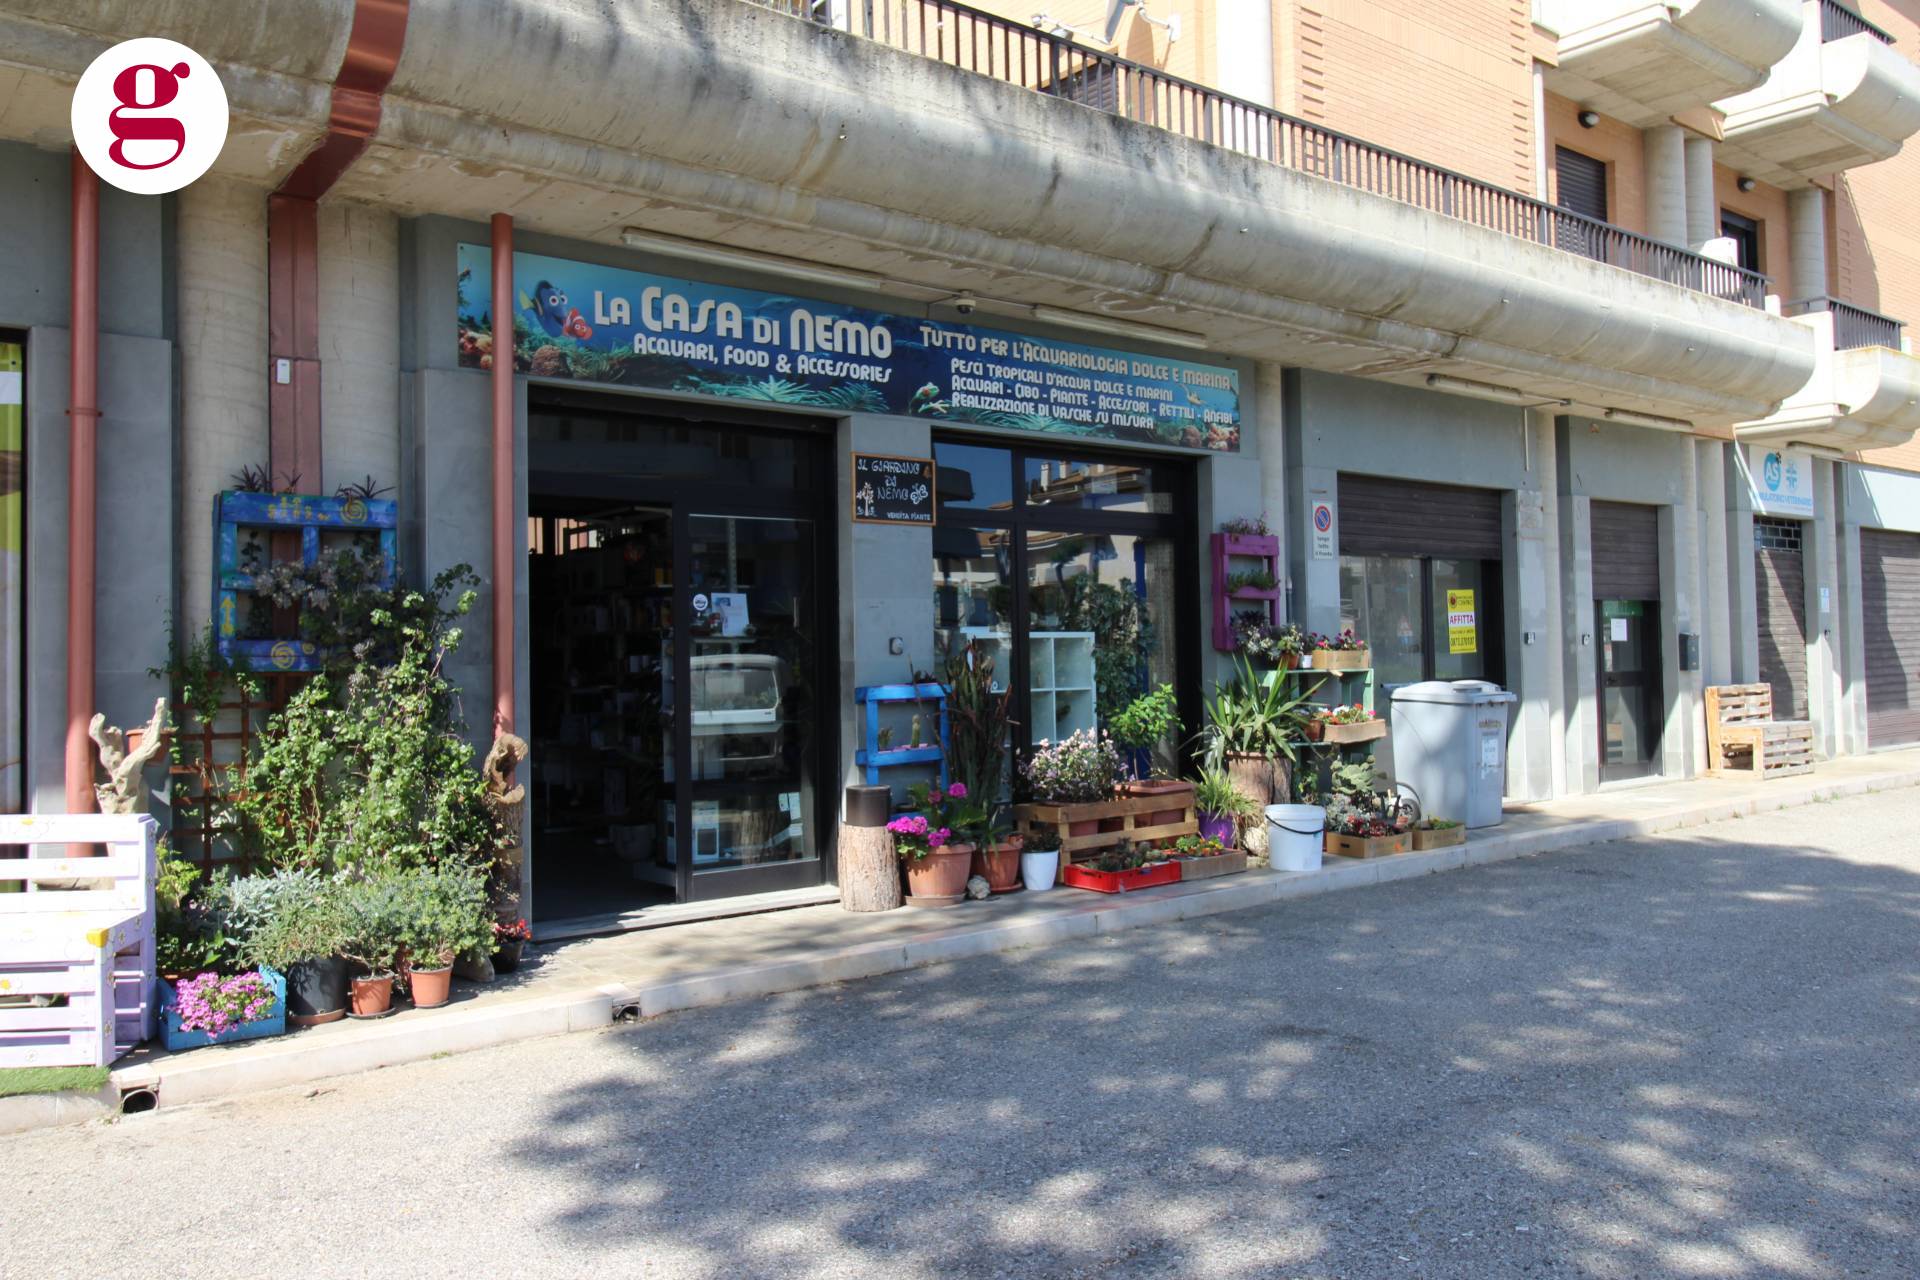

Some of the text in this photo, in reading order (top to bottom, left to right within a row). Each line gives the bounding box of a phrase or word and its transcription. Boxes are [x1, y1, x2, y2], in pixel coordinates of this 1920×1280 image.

[594, 286, 893, 359] LA CASA DI NEMO
[633, 333, 892, 383] ACQUARI, FOOD & ACCESSORIES
[919, 325, 1231, 390] TUTTO PER L'ACQUARIOLOGIA DOLCE E MARINA
[951, 357, 1173, 401] PESCI TROPICALI D'ACQUA DOLCE E MARINI
[951, 374, 1004, 395] ACQUARI
[1015, 383, 1040, 399] CIBO
[1050, 387, 1088, 406] PIANTE
[1099, 395, 1150, 414] ACCESSORI
[1159, 402, 1195, 419] RETTILI
[1204, 408, 1233, 425] ANFIBI
[951, 391, 1154, 430] REALIZZAZIONE DI VASCHE SU MISURA
[877, 486, 909, 500] NEMO
[1449, 614, 1474, 625] AFFITTA
